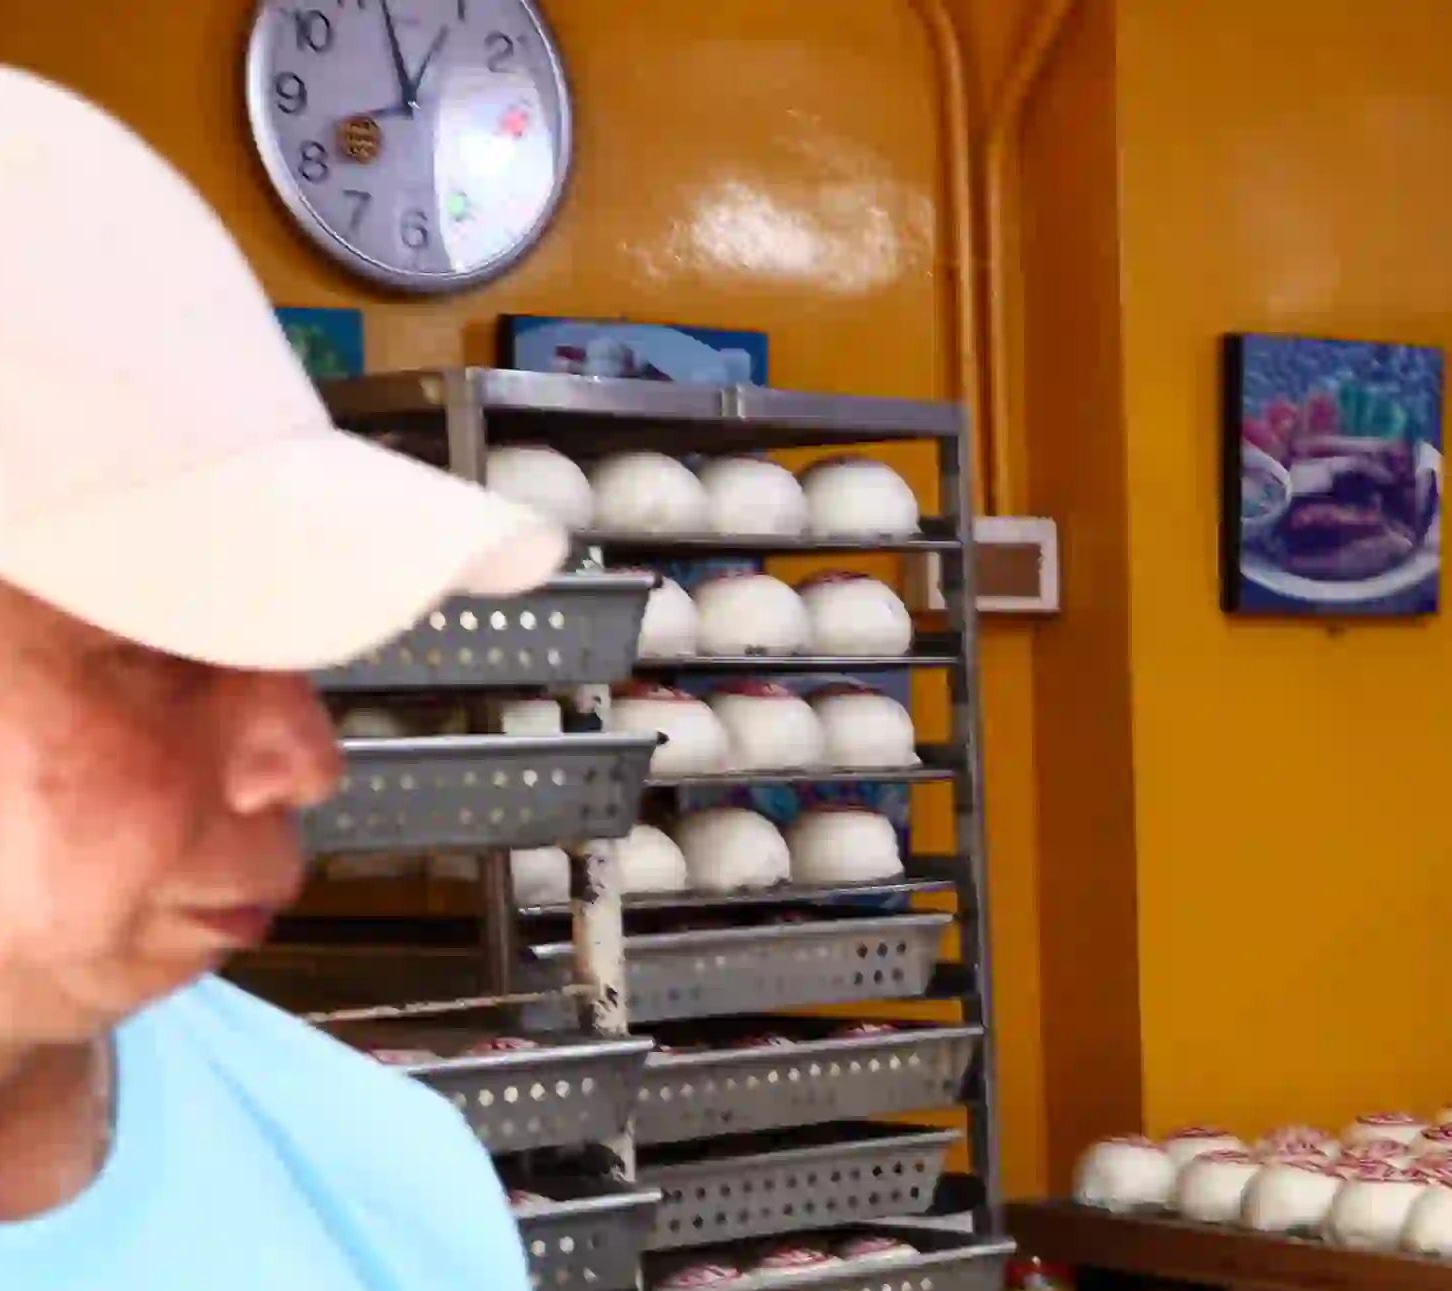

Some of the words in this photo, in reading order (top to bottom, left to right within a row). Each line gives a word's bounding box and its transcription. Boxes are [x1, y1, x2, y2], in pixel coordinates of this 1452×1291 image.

[482, 31, 515, 74] 2
[275, 70, 308, 115] 9
[298, 139, 329, 183] 8
[343, 189, 373, 232] 7
[401, 209, 429, 250] 6
